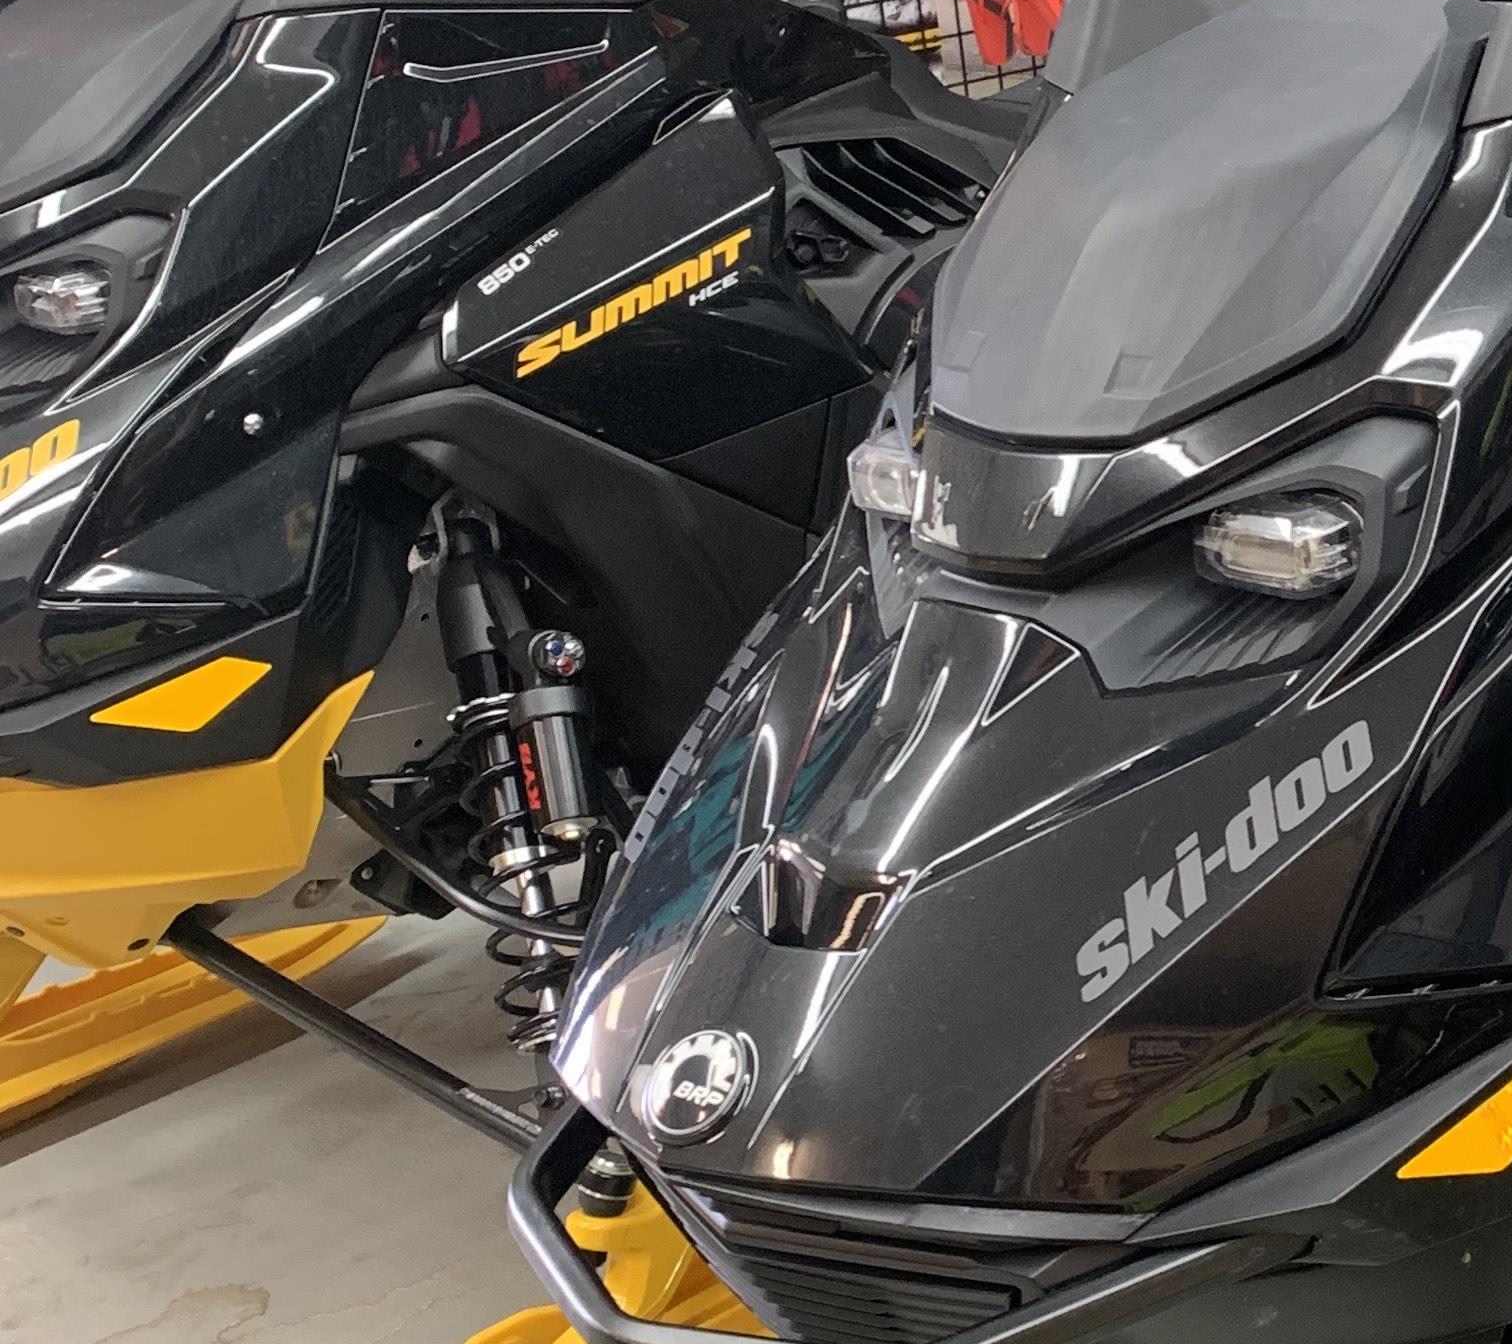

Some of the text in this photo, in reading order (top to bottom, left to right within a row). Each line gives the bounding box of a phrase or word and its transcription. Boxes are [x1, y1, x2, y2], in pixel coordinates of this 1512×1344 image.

[477, 228, 560, 296] 850 E-TEC
[688, 270, 740, 307] HCE
[516, 227, 752, 379] SUMMIT
[1075, 719, 1375, 1003] ski-doo
[673, 1080, 726, 1106] BRP
